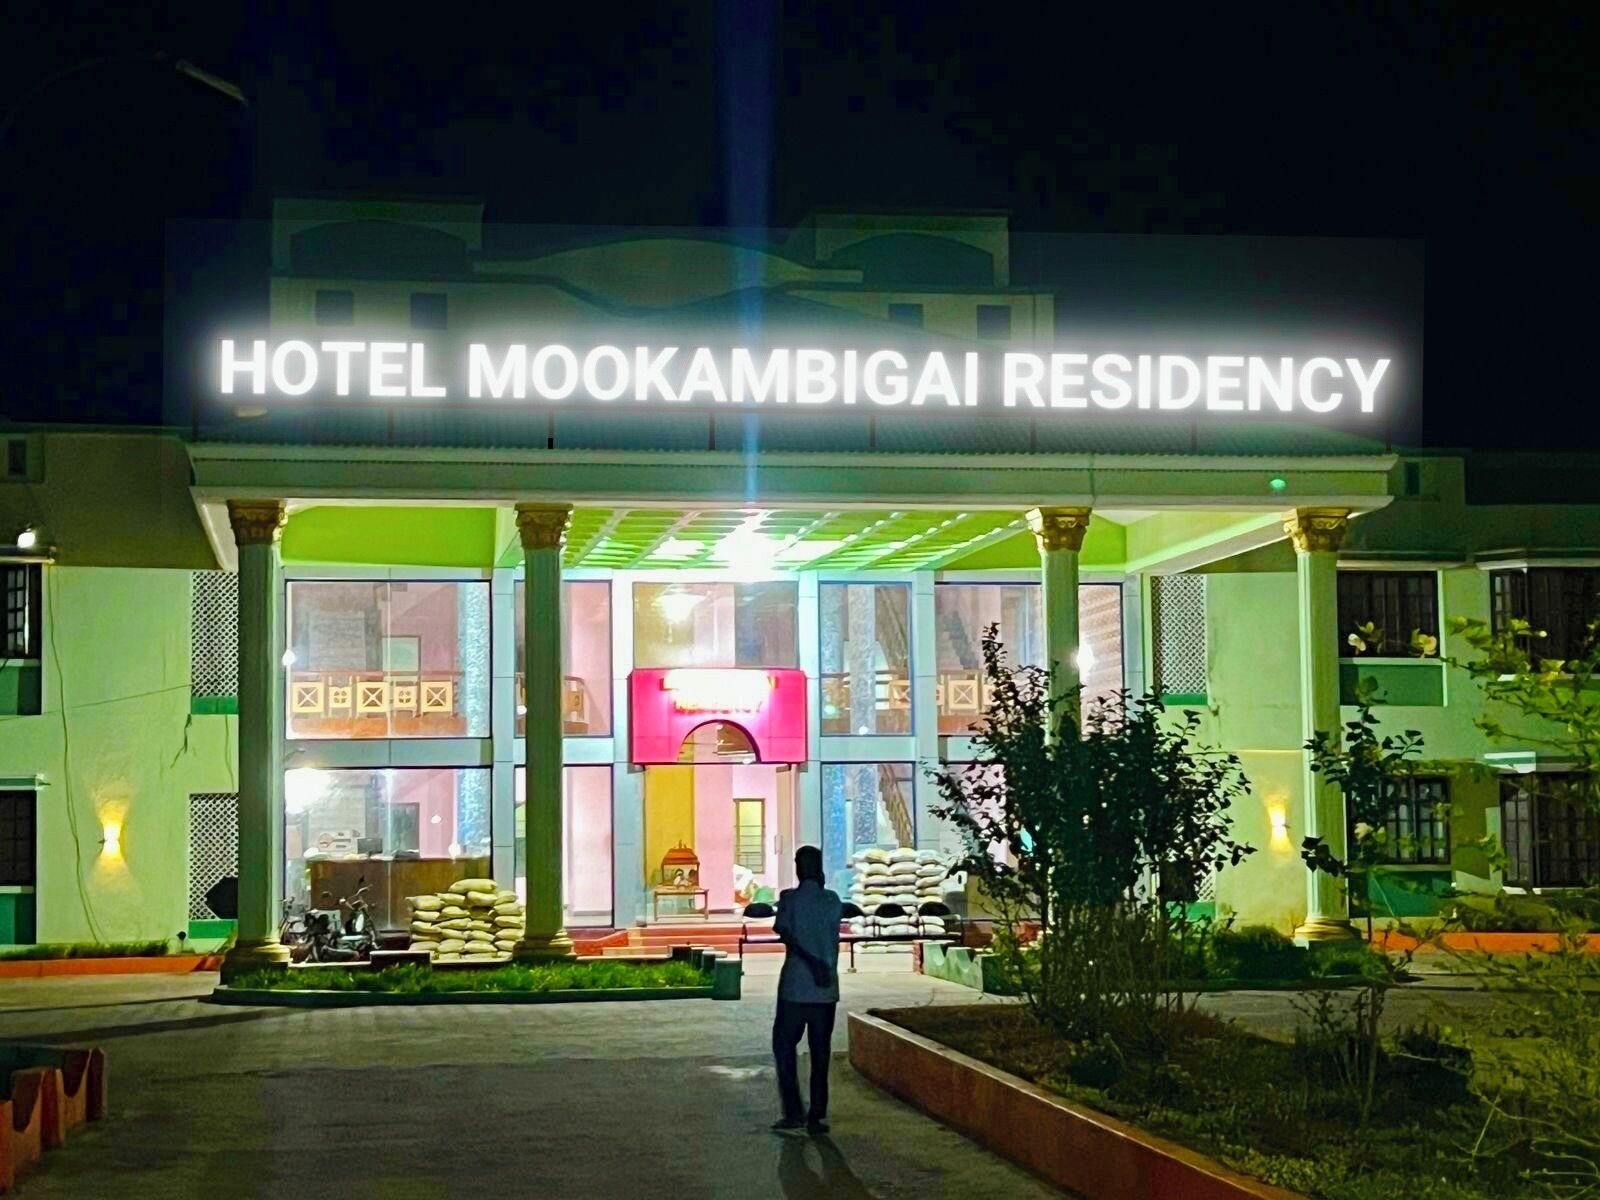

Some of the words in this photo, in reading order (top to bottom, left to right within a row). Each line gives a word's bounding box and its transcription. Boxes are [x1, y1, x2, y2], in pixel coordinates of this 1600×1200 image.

[221, 340, 446, 397] HOTEL
[469, 344, 978, 407] MOOKAMBIGAI
[1003, 353, 1391, 413] RESIDENCY
